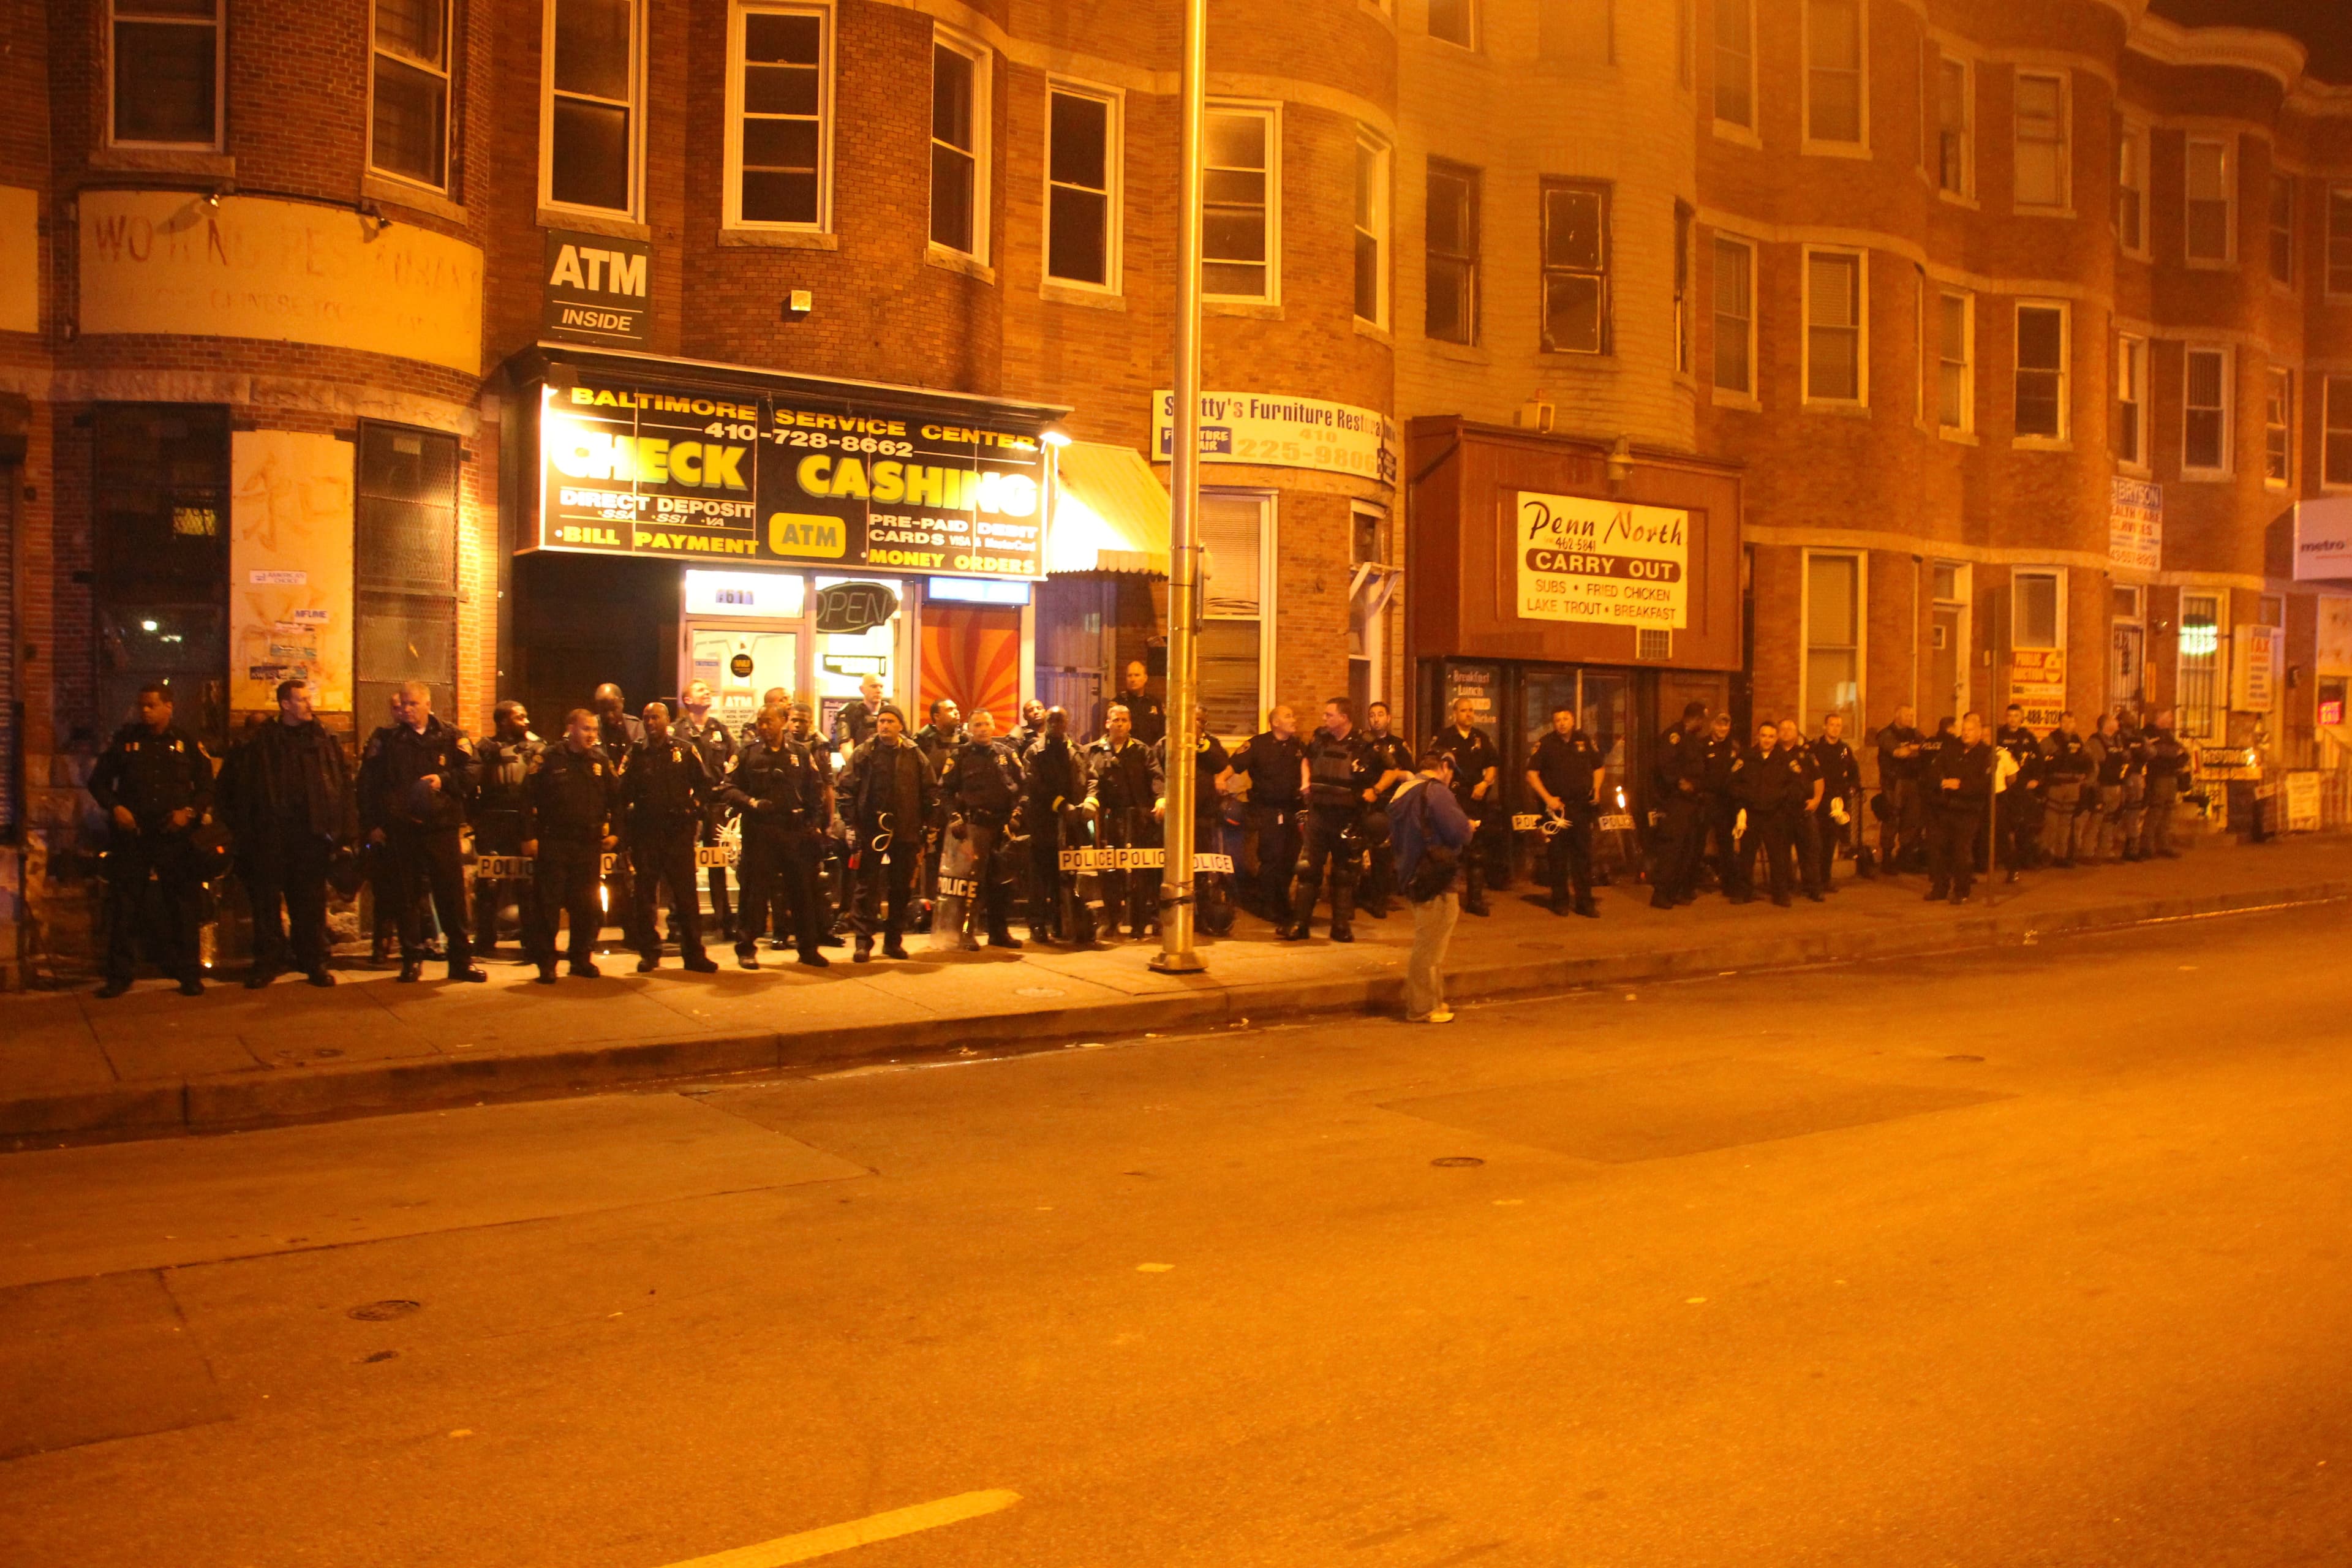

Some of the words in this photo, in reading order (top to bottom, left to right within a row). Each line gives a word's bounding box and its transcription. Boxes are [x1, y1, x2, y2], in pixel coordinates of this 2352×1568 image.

[550, 244, 646, 297] ATM
[562, 309, 632, 331] INSIDE
[571, 387, 757, 420] BALTIMORE
[775, 409, 907, 437] SERVICE
[921, 424, 1039, 451] CENTER
[1164, 395, 1243, 420] Stty's
[1251, 399, 1332, 426] Furniture
[705, 422, 913, 458] 410-728-8662
[1164, 430, 1229, 442] FTURE
[1299, 428, 1338, 443] 410
[1199, 440, 1218, 451] AIR
[1238, 438, 1376, 473] 225-9806
[550, 429, 748, 491] CHECK
[797, 453, 1038, 518] CASHING
[560, 490, 650, 511] DIRECT
[657, 498, 755, 518] DEPOSIT
[601, 509, 636, 521] SSA
[655, 513, 688, 524] SSI
[705, 517, 725, 527] VA
[869, 513, 968, 532] PRE-PAID
[977, 522, 1038, 539] DEBIT
[1524, 500, 1595, 540] Penn
[1604, 511, 1681, 546] North
[564, 526, 620, 545] BILL
[635, 531, 759, 554] PAYMENT
[782, 524, 838, 547] ATM
[869, 529, 946, 546] CARDS
[949, 535, 971, 547] VISA
[1555, 536, 1597, 552] 462-5841
[2301, 541, 2345, 552] metro
[869, 549, 946, 568] MONEY
[954, 554, 1036, 575] ORDERS
[1535, 552, 1616, 575] CARRY
[1629, 560, 1673, 579] OUT
[1535, 579, 1566, 594] SUBS
[1587, 584, 1618, 598] FRIED
[1624, 586, 1671, 601] CHICKEN
[1527, 598, 1558, 613] LAKE
[1564, 600, 1601, 615] TROUT
[1615, 605, 1676, 621] BREAKFAST
[724, 696, 753, 707] ATM
[481, 858, 534, 876] POLIC
[1063, 851, 1113, 867] POLICE
[1120, 851, 1164, 865] POLIC
